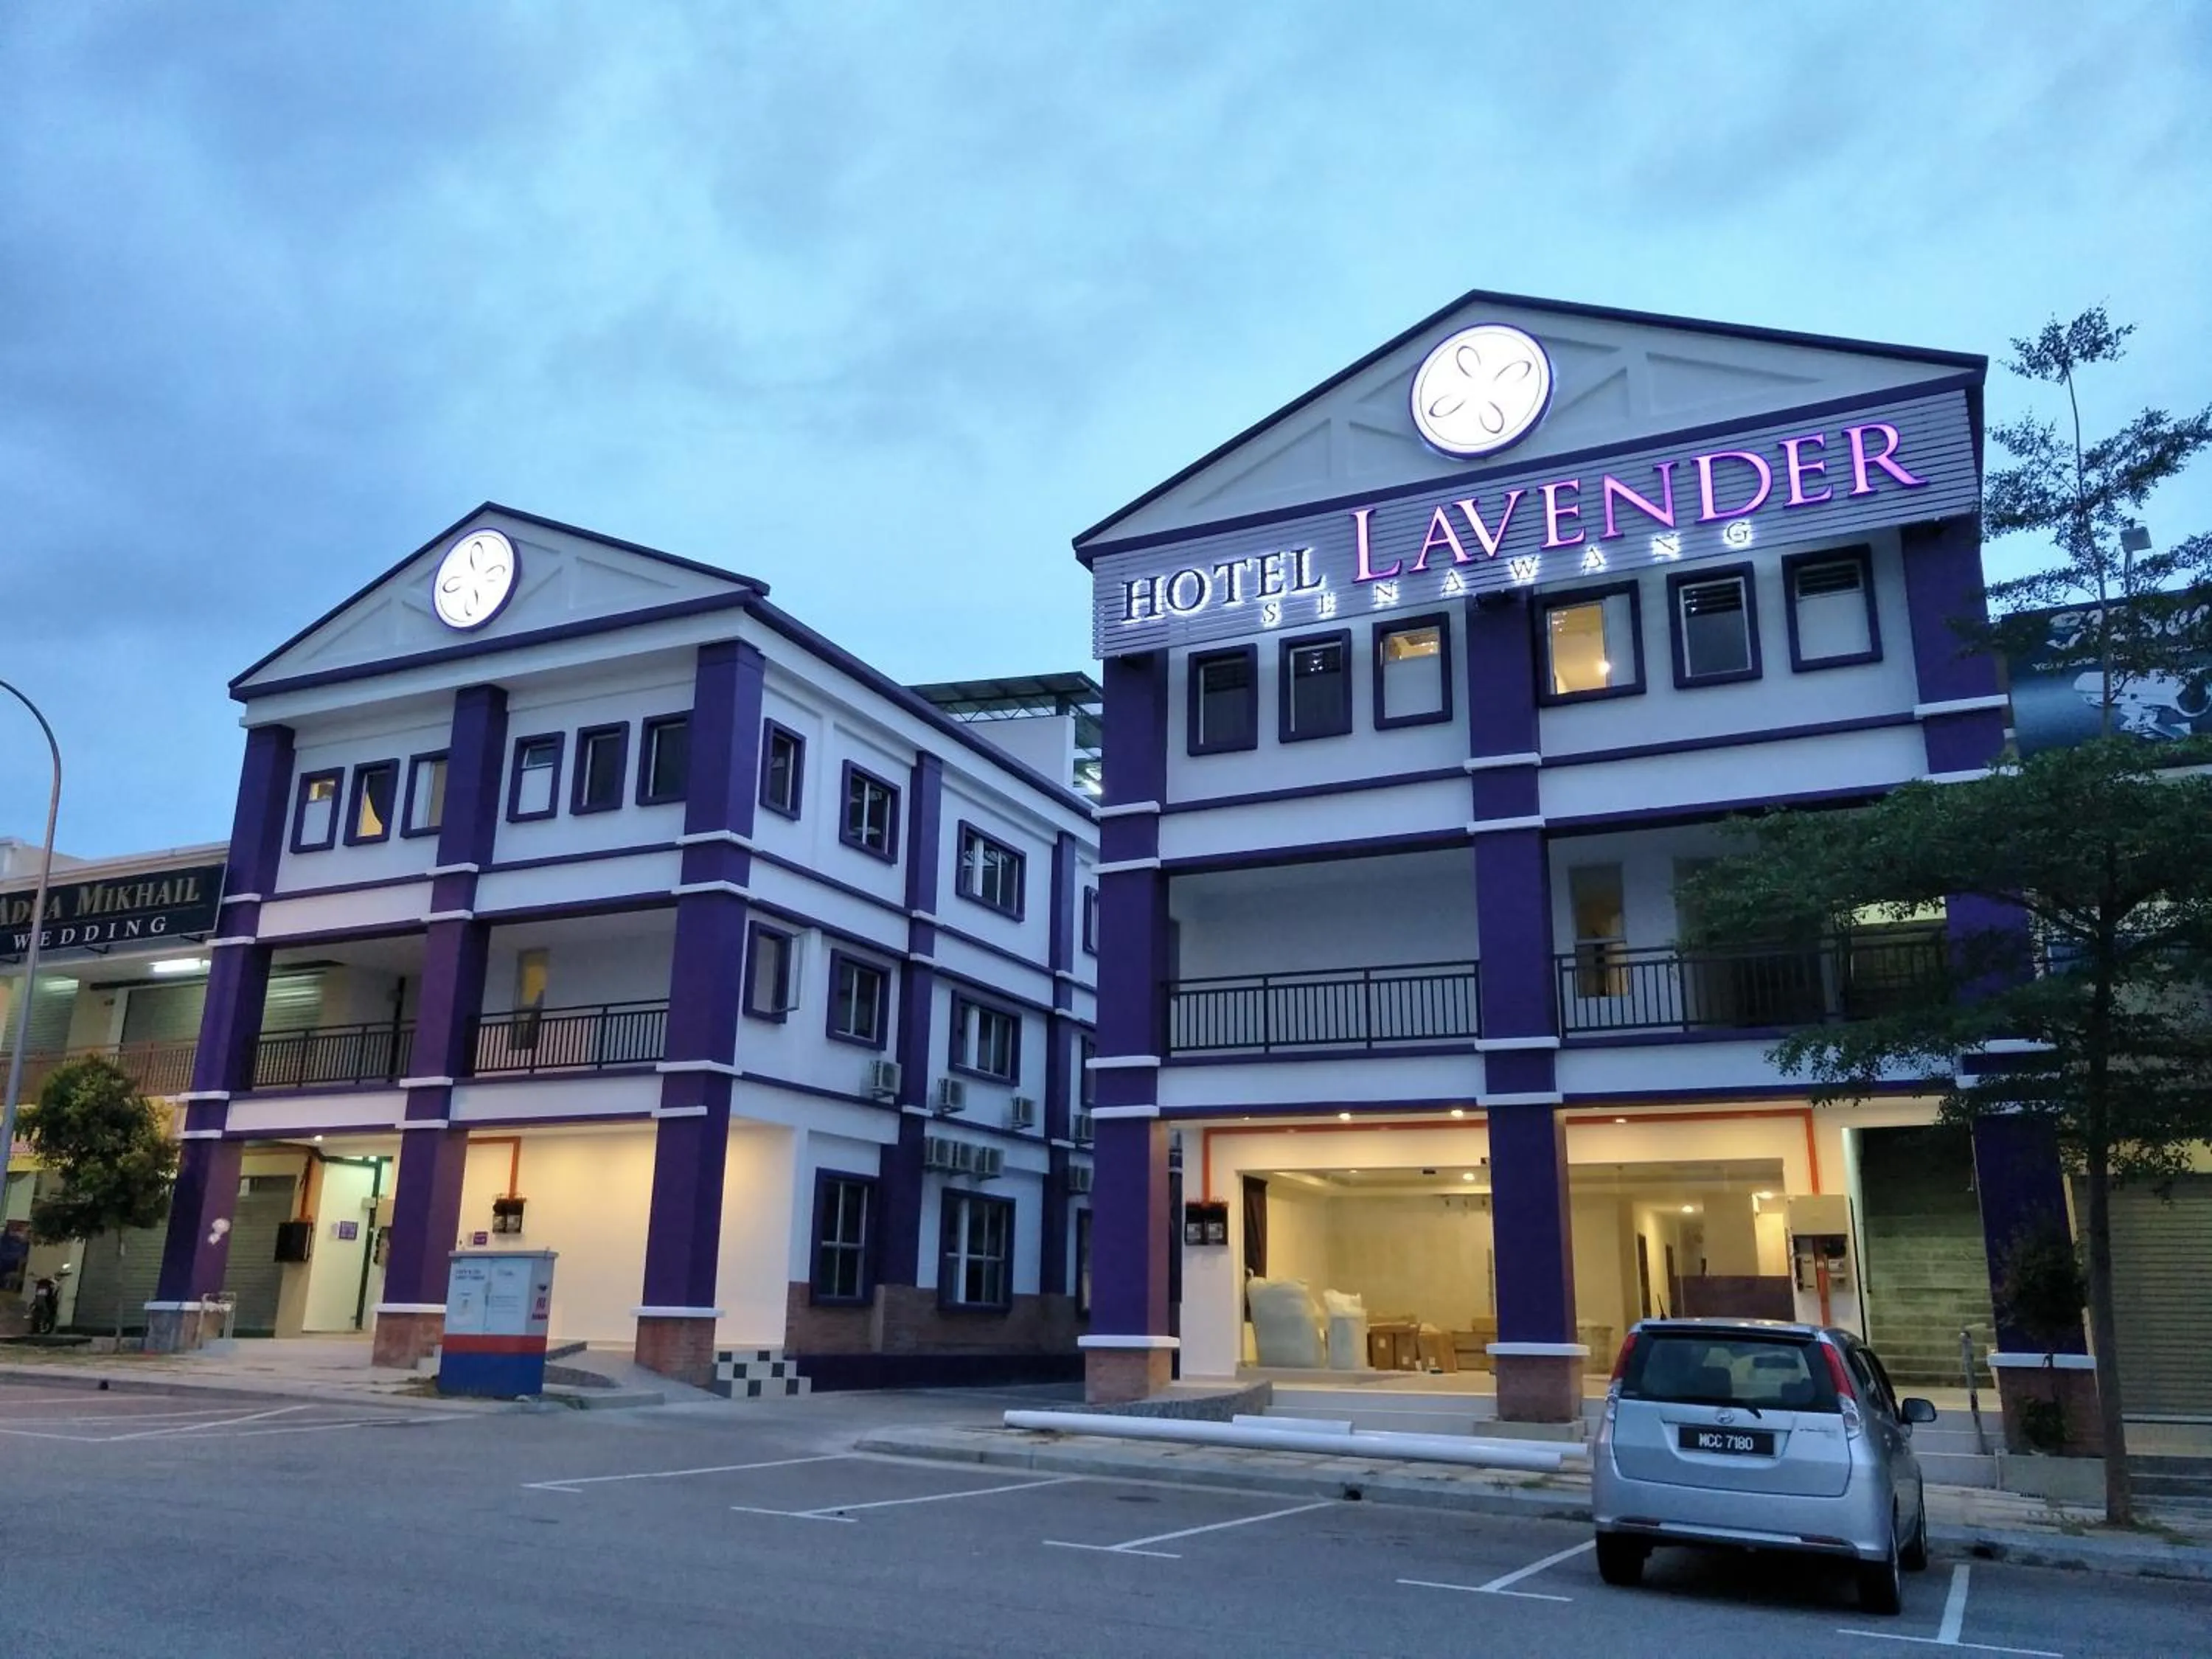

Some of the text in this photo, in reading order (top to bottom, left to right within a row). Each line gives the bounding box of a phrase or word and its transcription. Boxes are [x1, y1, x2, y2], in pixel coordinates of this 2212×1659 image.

[1120, 422, 1930, 622] HOTEL LAVENDER
[1262, 519, 1753, 624] SENAWANG
[75, 877, 201, 917] MIKHAIL
[14, 917, 167, 950] WEDDING
[1726, 1434, 1754, 1450] 7180
